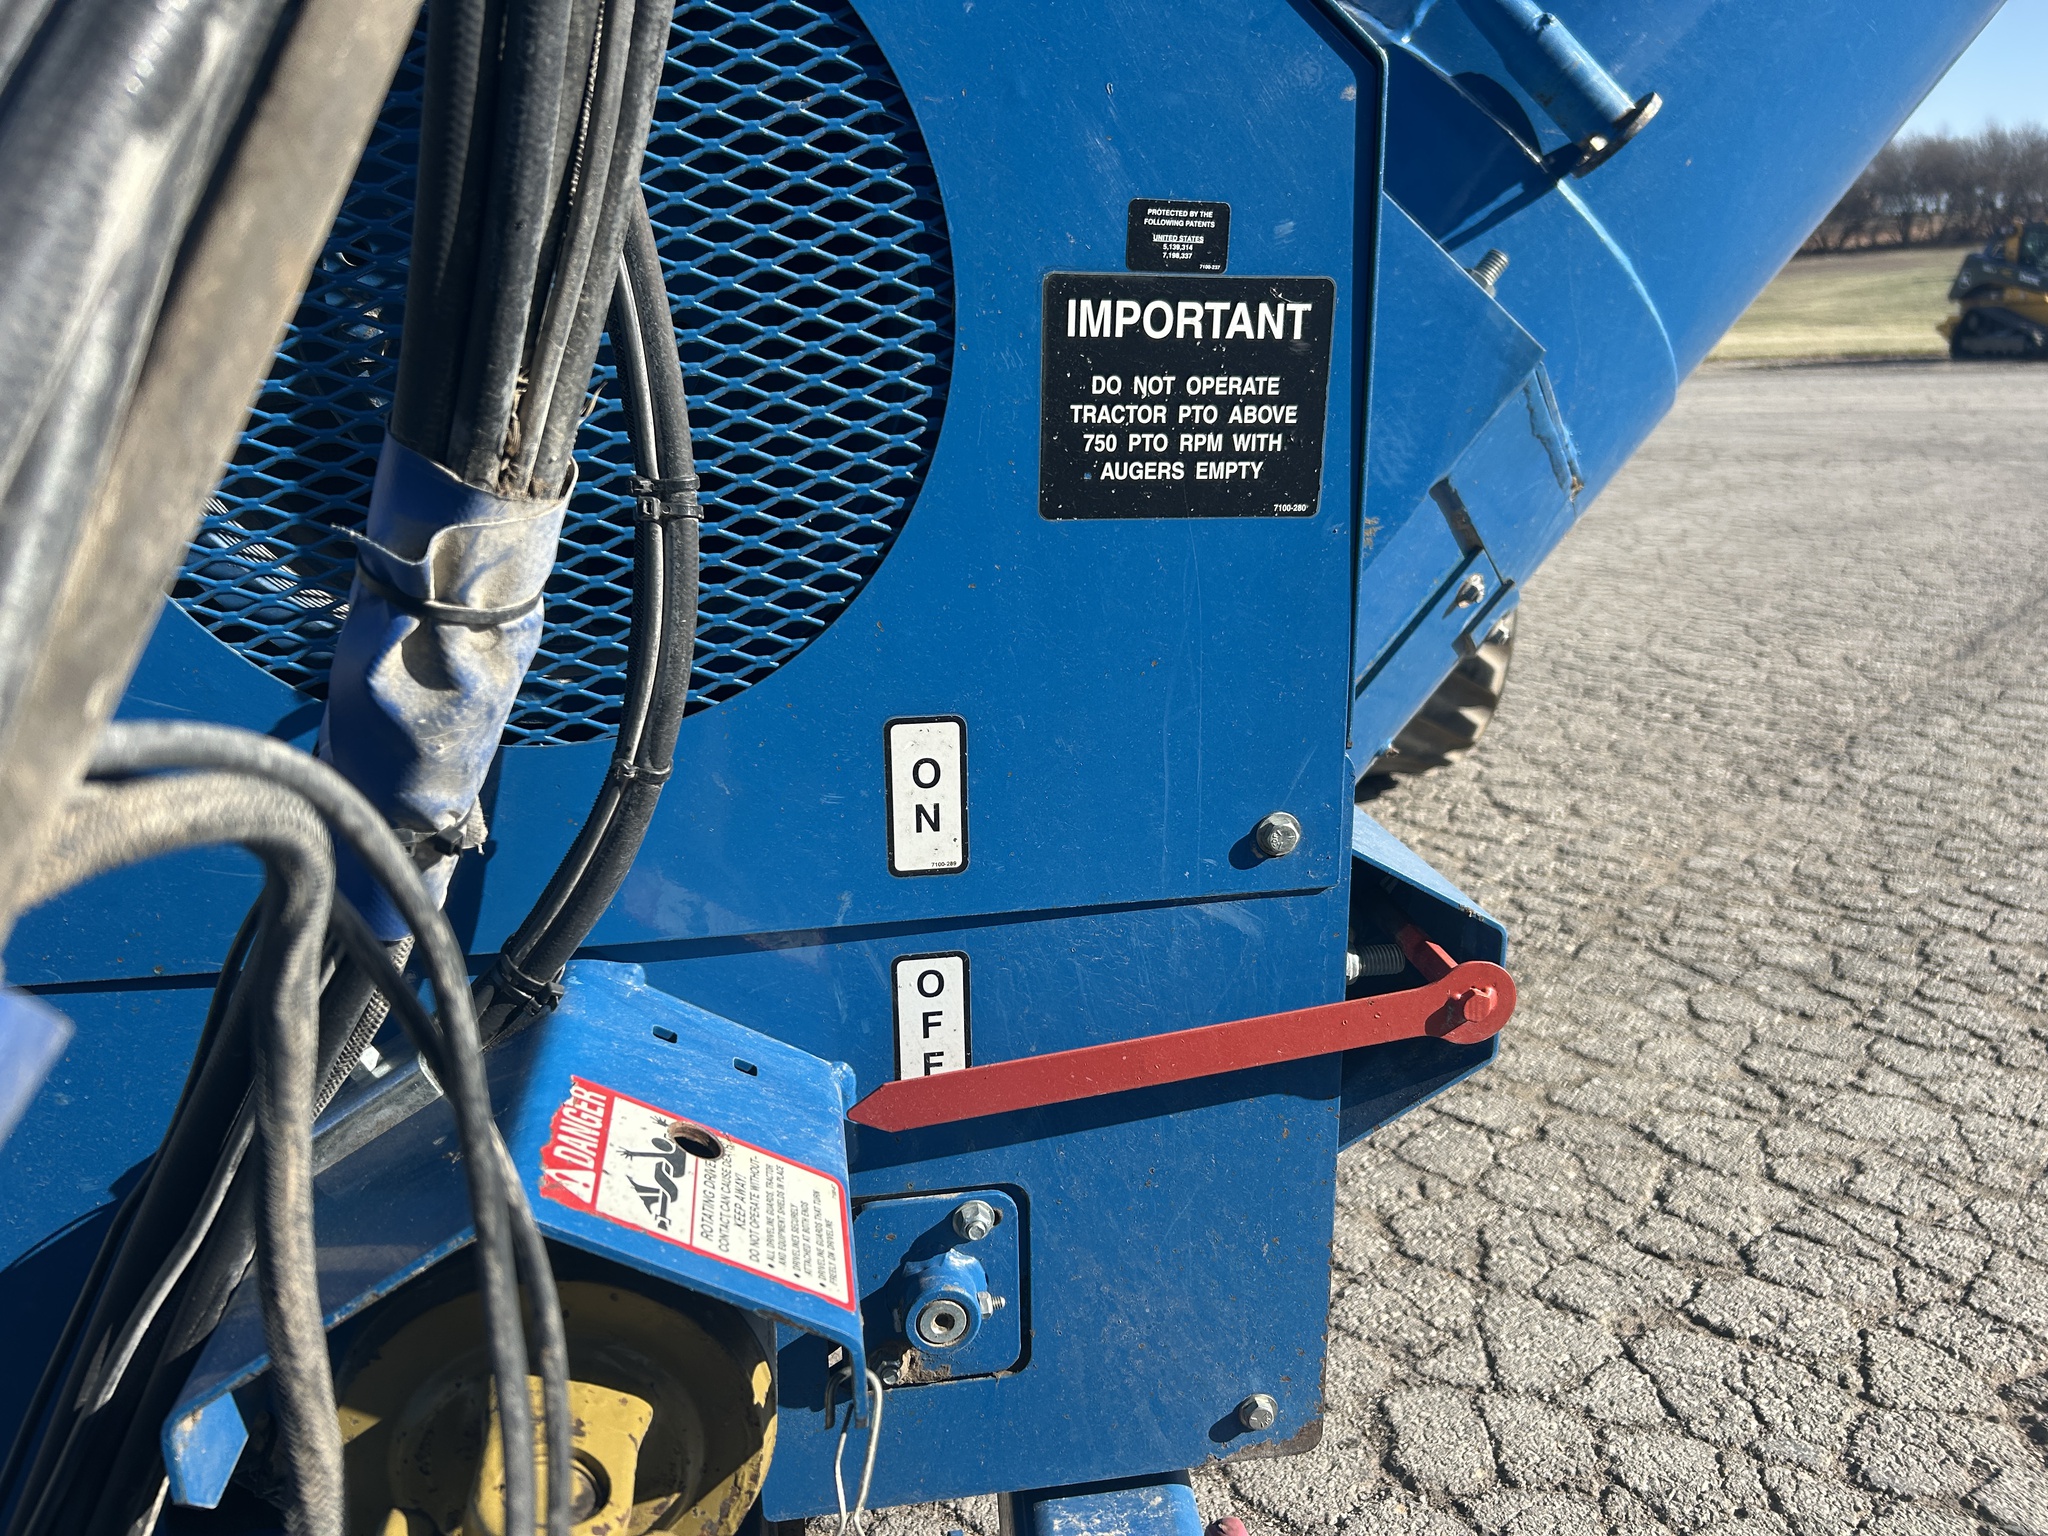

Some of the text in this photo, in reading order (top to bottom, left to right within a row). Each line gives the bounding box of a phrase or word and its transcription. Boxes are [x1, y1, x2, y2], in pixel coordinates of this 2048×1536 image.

[1144, 218, 1215, 228] FOLLOWING PATENTS
[1147, 208, 1188, 217] PROTECTED
[1189, 210, 1198, 218] BY
[1153, 234, 1204, 243] UNITED STATES
[1066, 298, 1312, 340] IMPORTANT
[1091, 375, 1281, 396] DO NOT OPERATE
[1070, 404, 1298, 424] TRACTOR PTO ABOVE
[1082, 433, 1283, 453] 750 PTO RPM WITH
[1100, 462, 1264, 481] AUGERS EMPTY
[1273, 503, 1307, 512] 7100-280
[912, 757, 941, 833] ON
[916, 969, 945, 1077] OFF
[553, 1084, 607, 1167] DANGER
[721, 1167, 731, 1194] CAUSE
[765, 1163, 773, 1189] TRACTOR
[720, 1193, 730, 1212] CAN
[733, 1172, 746, 1230] KEEP AWAY!
[749, 1191, 759, 1229] OPERATE
[700, 1188, 714, 1242] ROTATING
[775, 1164, 786, 1266] AND EQUIPMENT SHIELDS IN PLACE
[790, 1202, 799, 1234] SECURELY
[718, 1211, 730, 1252] CONTACT
[749, 1228, 759, 1248] NOT
[766, 1215, 774, 1249] DRIVELINE
[749, 1247, 759, 1262] DO
[766, 1249, 775, 1262] ALL
